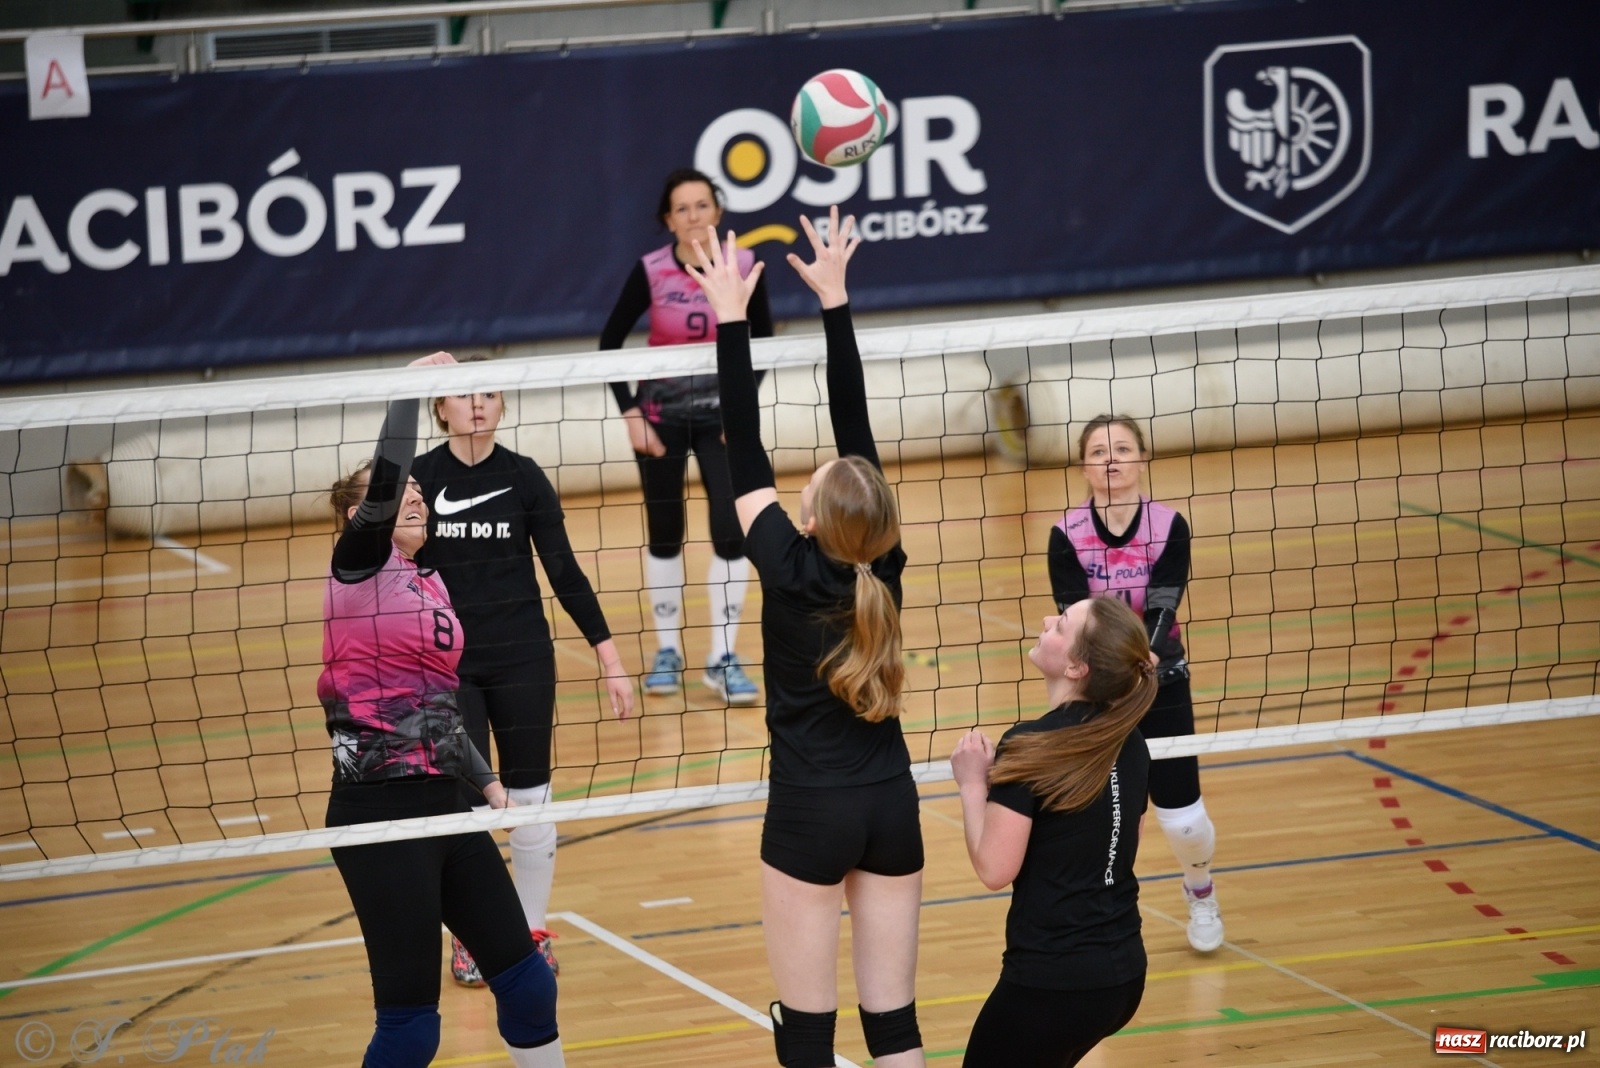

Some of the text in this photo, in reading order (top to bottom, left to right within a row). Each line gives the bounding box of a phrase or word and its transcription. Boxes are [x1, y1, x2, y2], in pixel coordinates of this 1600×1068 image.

[41, 59, 75, 101] A
[1467, 77, 1600, 160] RA
[686, 312, 708, 340] 9
[435, 521, 467, 538] JUST
[471, 522, 493, 539] DO
[433, 609, 455, 652] 8
[1110, 771, 1120, 803] KLEIN
[1104, 803, 1121, 886] PERFORMANCE
